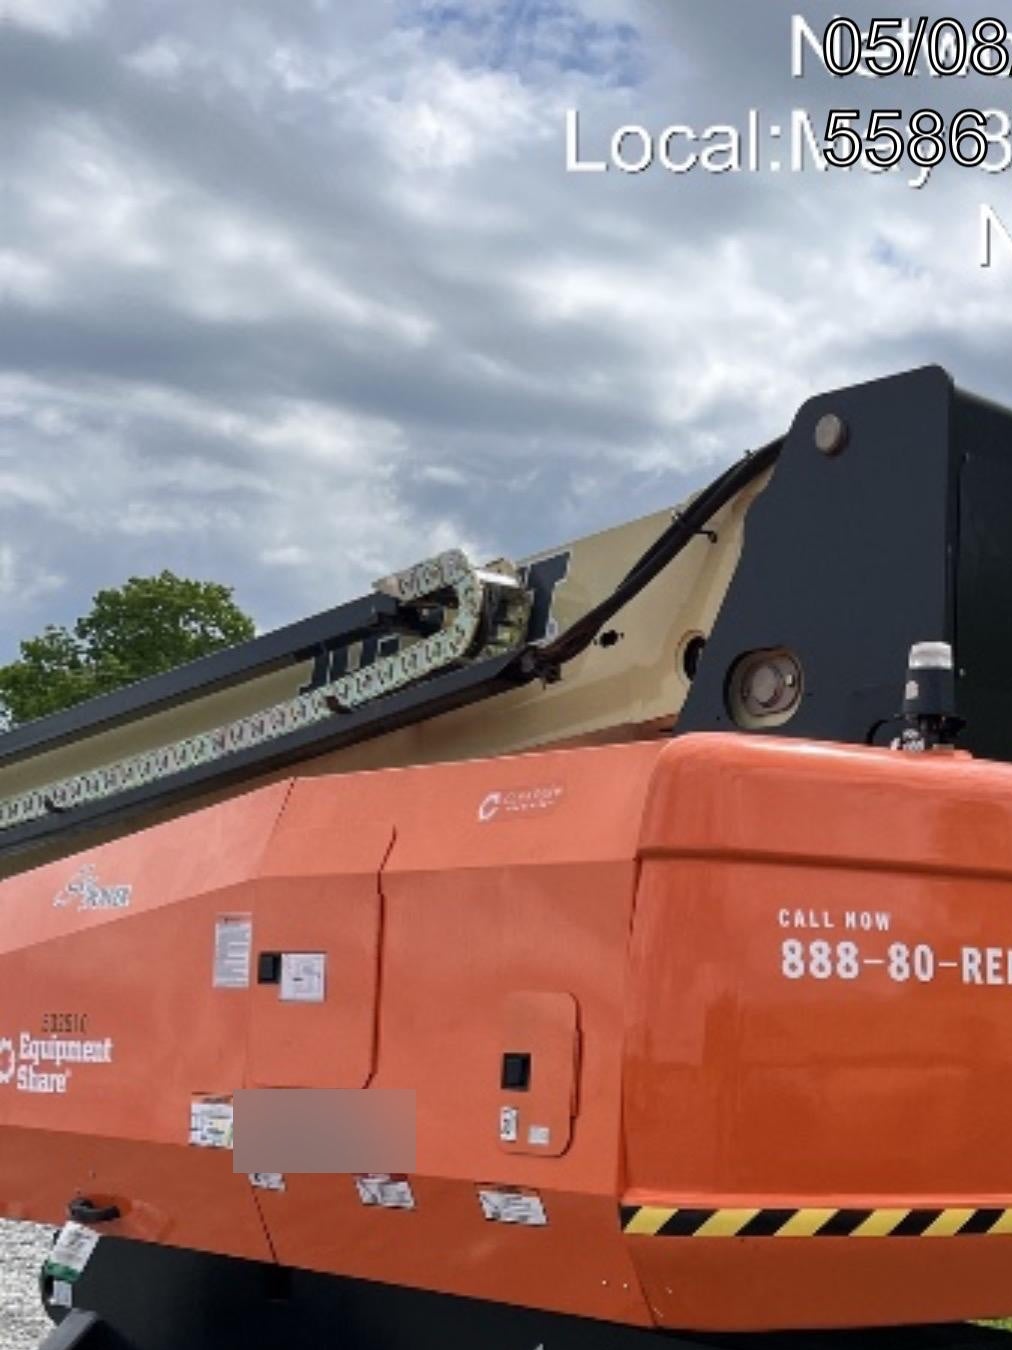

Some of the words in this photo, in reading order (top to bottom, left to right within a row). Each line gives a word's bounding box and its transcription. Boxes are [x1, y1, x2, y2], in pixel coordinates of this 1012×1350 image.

[778, 908, 835, 929] CALL
[845, 911, 892, 932] NOW
[20, 1032, 113, 1067] Equipment
[17, 1064, 67, 1093] Share
